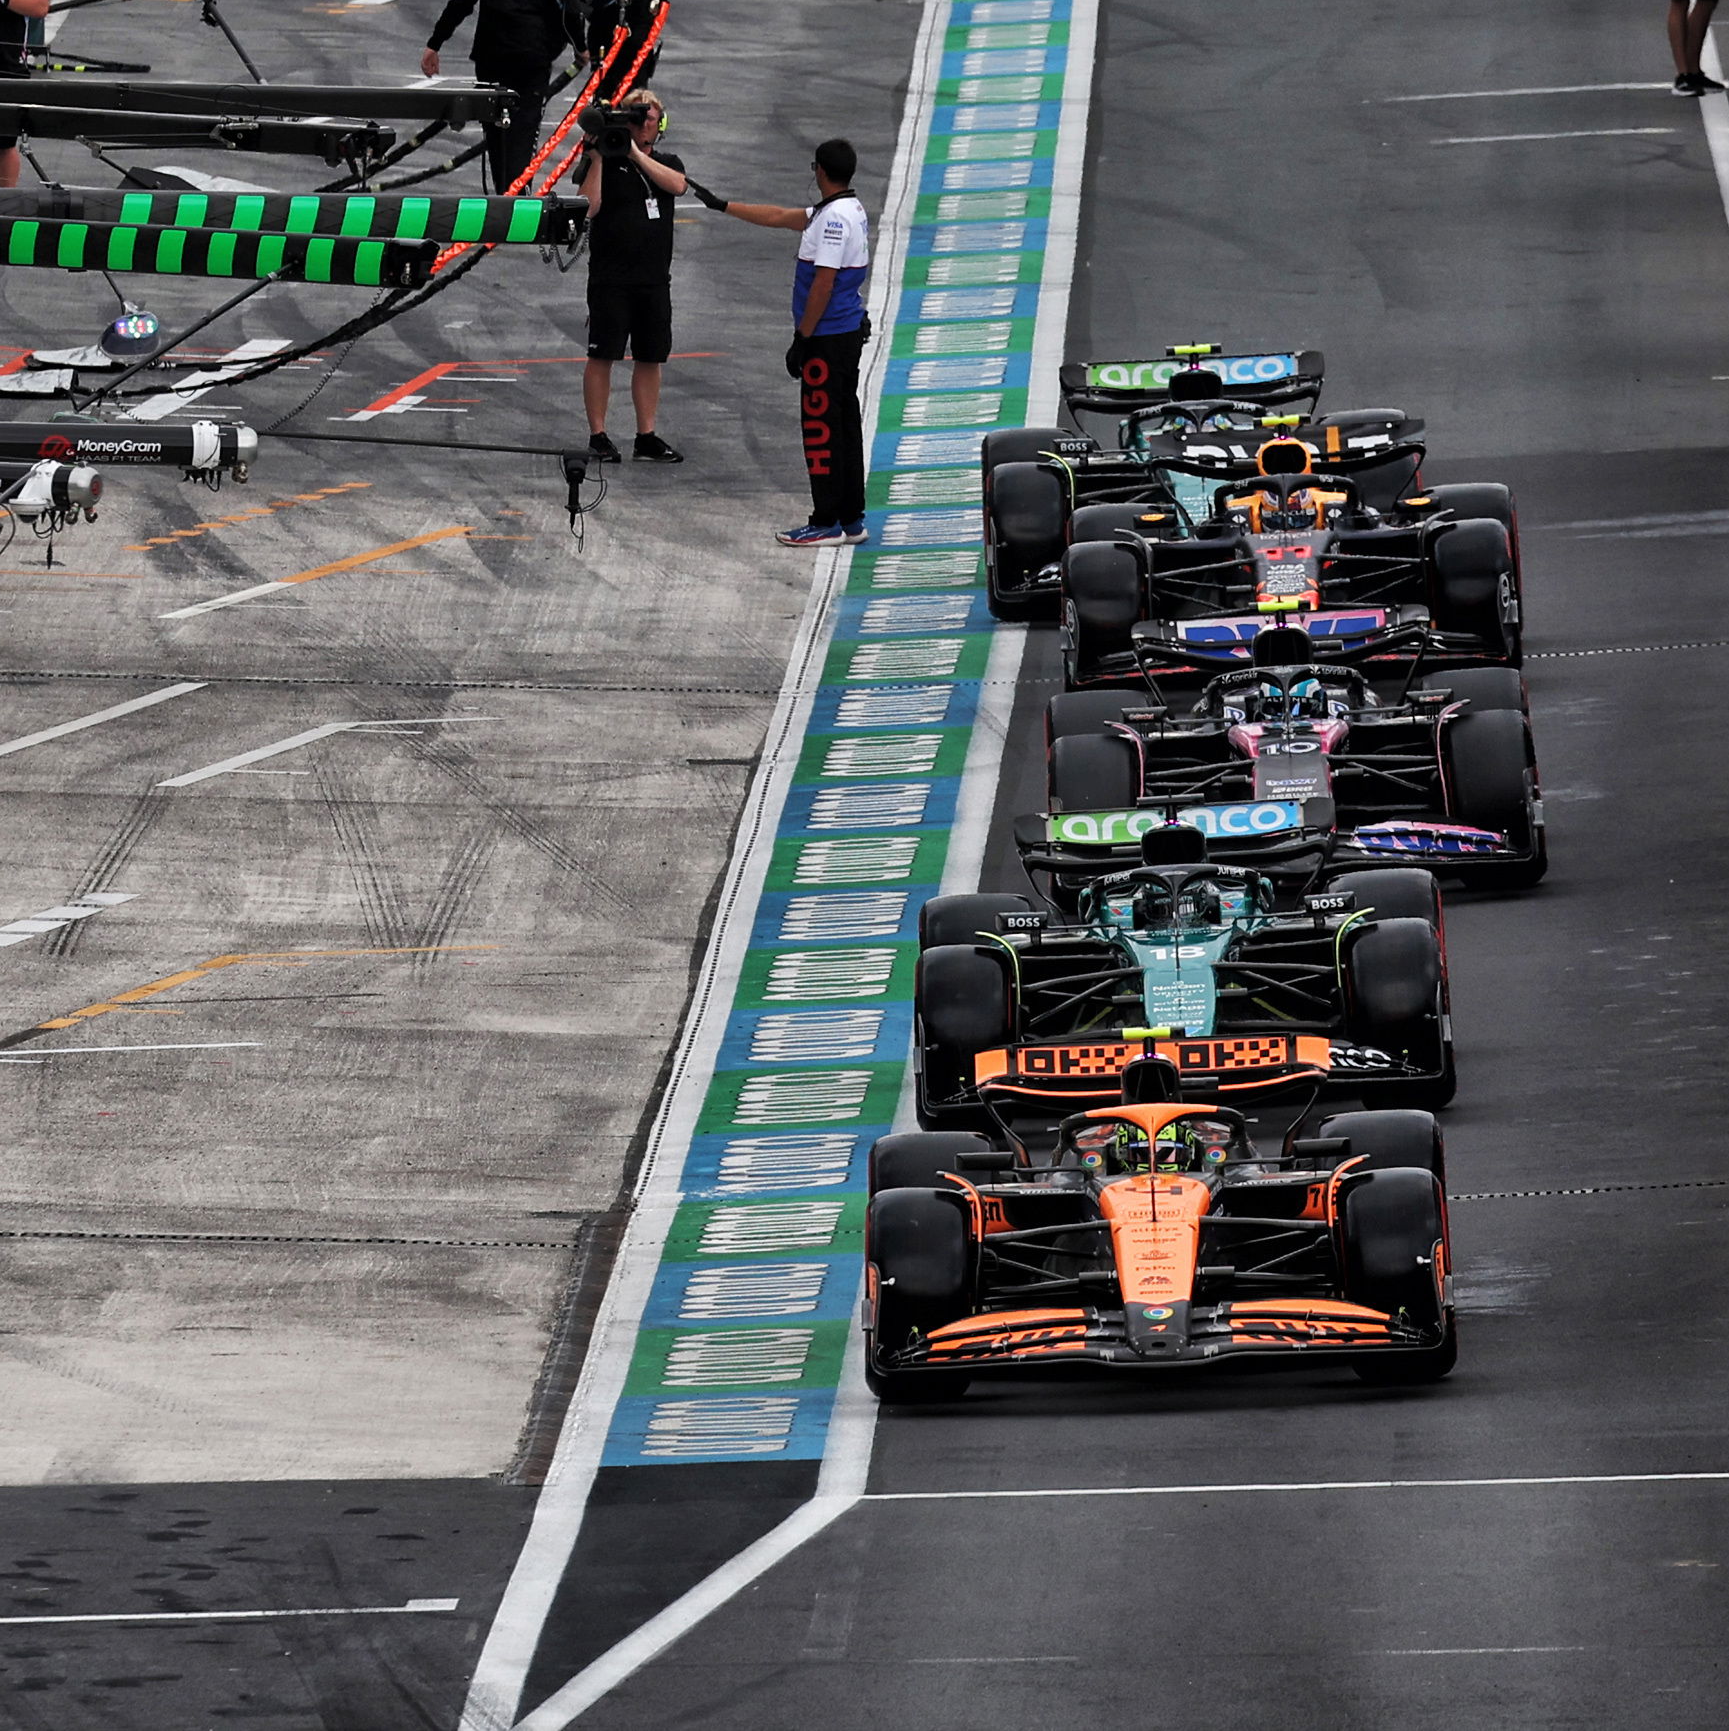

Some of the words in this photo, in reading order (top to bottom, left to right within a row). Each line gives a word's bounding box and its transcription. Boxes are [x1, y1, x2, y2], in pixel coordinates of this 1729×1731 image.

[827, 221, 843, 229] VISA
[803, 357, 831, 475] HUGO
[77, 438, 162, 455] MoneyGram
[1060, 442, 1087, 452] BOSS
[1311, 897, 1344, 910] BOSS
[1007, 917, 1039, 928] BOSS
[1149, 946, 1206, 961] 18
